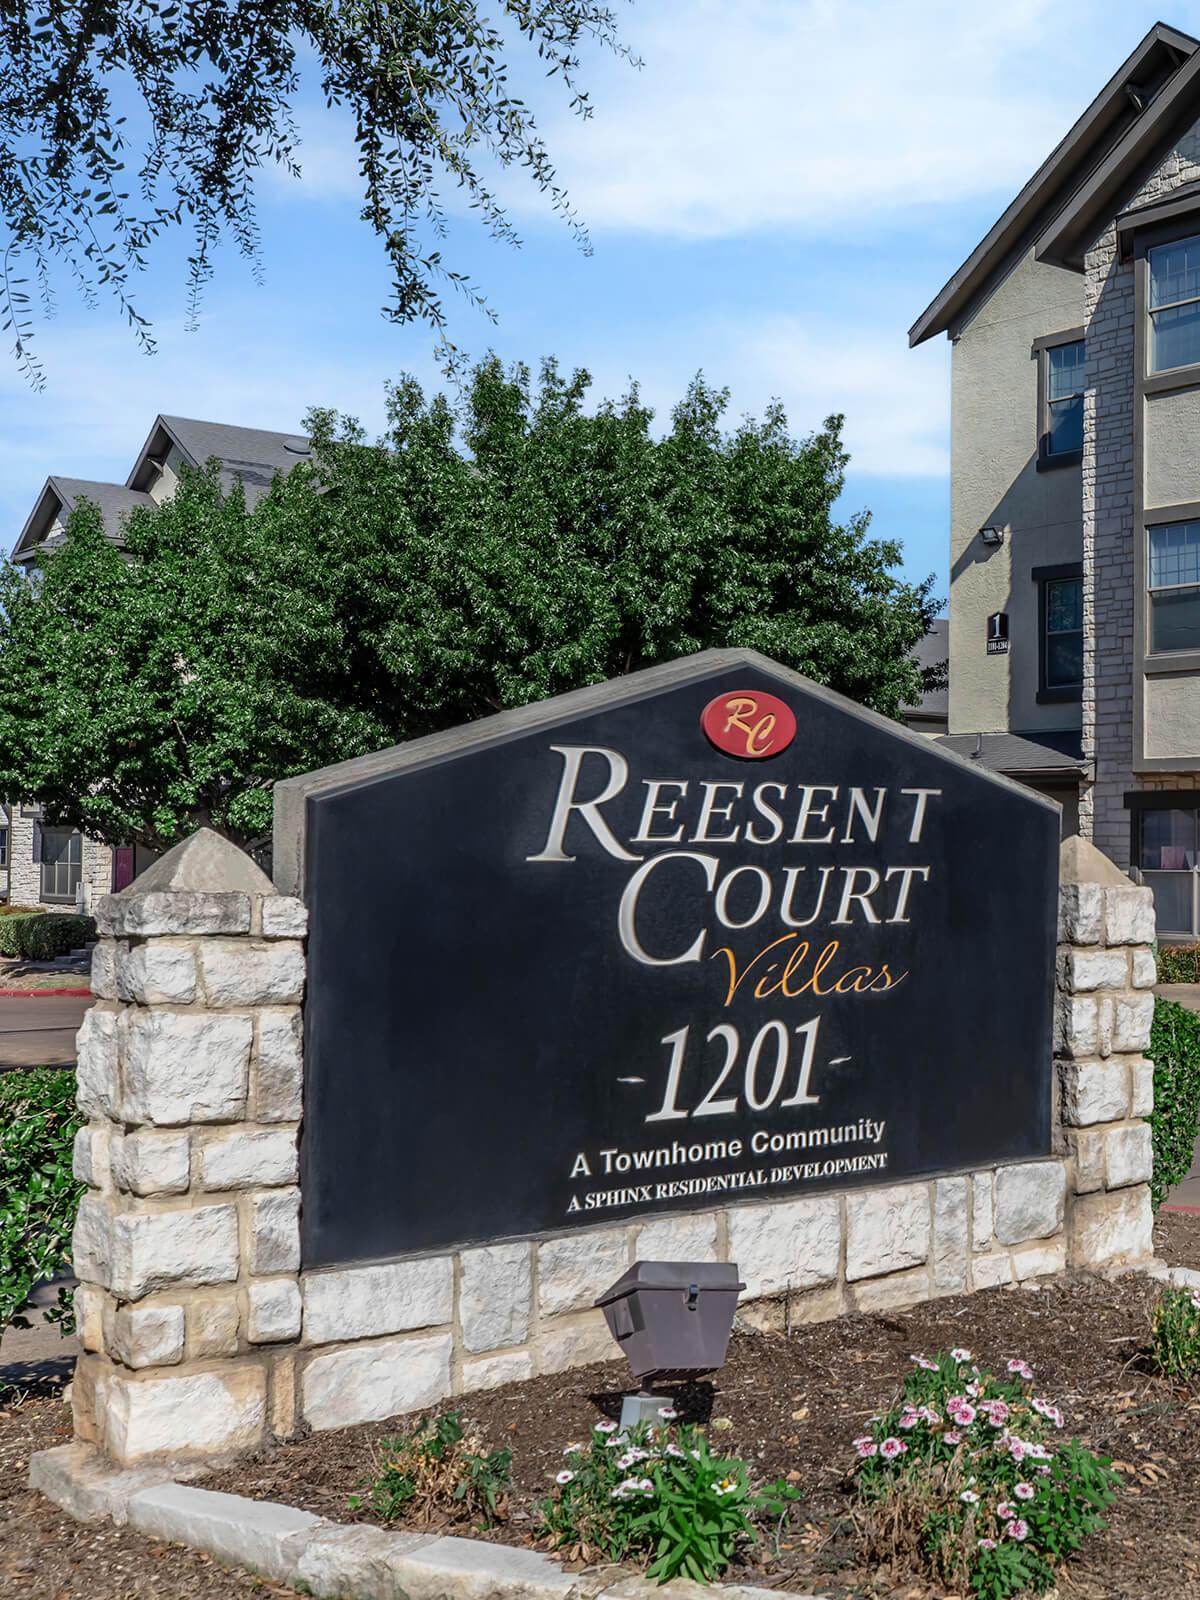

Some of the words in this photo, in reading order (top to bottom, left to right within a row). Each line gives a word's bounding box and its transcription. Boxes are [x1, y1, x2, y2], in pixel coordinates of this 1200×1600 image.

[992, 613, 1001, 638] 1
[617, 849, 930, 967] COURT
[709, 931, 910, 1008] Villas
[568, 1152, 592, 1179] A
[600, 1138, 743, 1175] Townhome
[750, 1116, 887, 1155] Community
[566, 1196, 583, 1213] A
[584, 1184, 654, 1211] SPHINX
[655, 1168, 769, 1200] RESIDENTIAL
[770, 1152, 889, 1184] DEVELOPMENT
